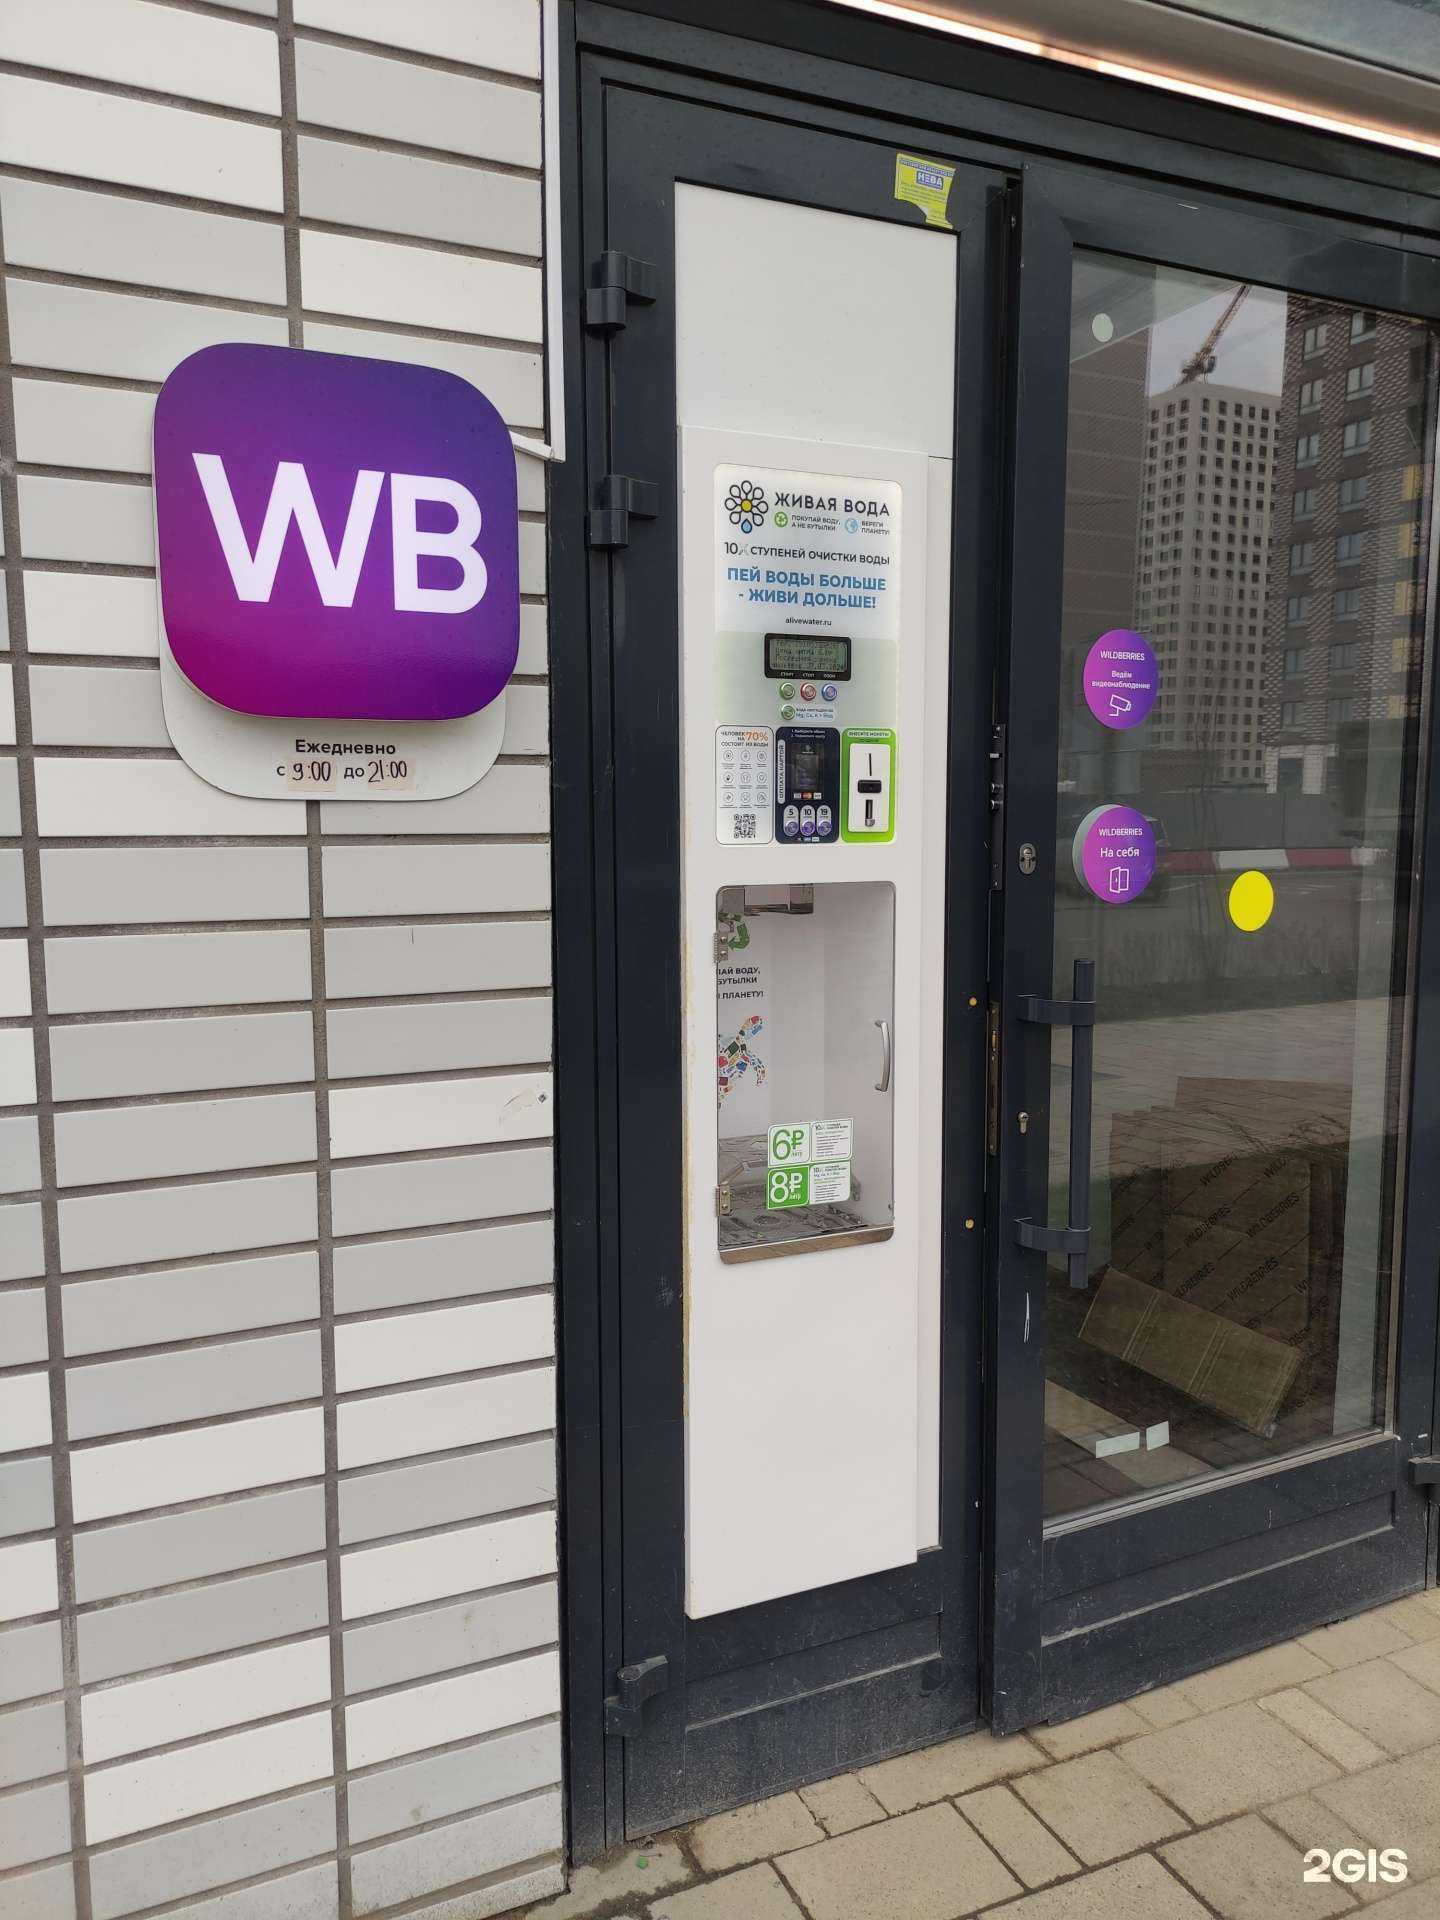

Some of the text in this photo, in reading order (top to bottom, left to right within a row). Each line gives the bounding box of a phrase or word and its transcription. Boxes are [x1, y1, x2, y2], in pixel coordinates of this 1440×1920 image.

[774, 492, 890, 517] ЖИВАЯ ВОДА
[792, 514, 821, 522] ПОКУПАЙ
[192, 452, 488, 614] WB
[750, 546, 805, 559] СТУПЕНЕЙ
[808, 550, 857, 562] ОЧИСТКИ
[860, 555, 890, 565] ВОДЫ
[728, 566, 886, 590] ПЕЙ ВОДЫ БОЛЬШЕ
[749, 589, 798, 604] ЖИВИ
[803, 592, 876, 608] ДОЛЬШЕ!
[785, 617, 832, 627] alivewater.ru
[1100, 650, 1145, 661] WILDBERRIES
[1112, 670, 1132, 679] Ведём
[1092, 680, 1151, 690] видеонаблюдение
[746, 732, 768, 741] 70%
[295, 738, 396, 756] Ежедневно
[291, 760, 332, 782] 9:00
[344, 765, 365, 781] до
[368, 760, 408, 783] 21:00
[1099, 827, 1143, 836] WILDBERRIES
[1100, 847, 1140, 857] На себя
